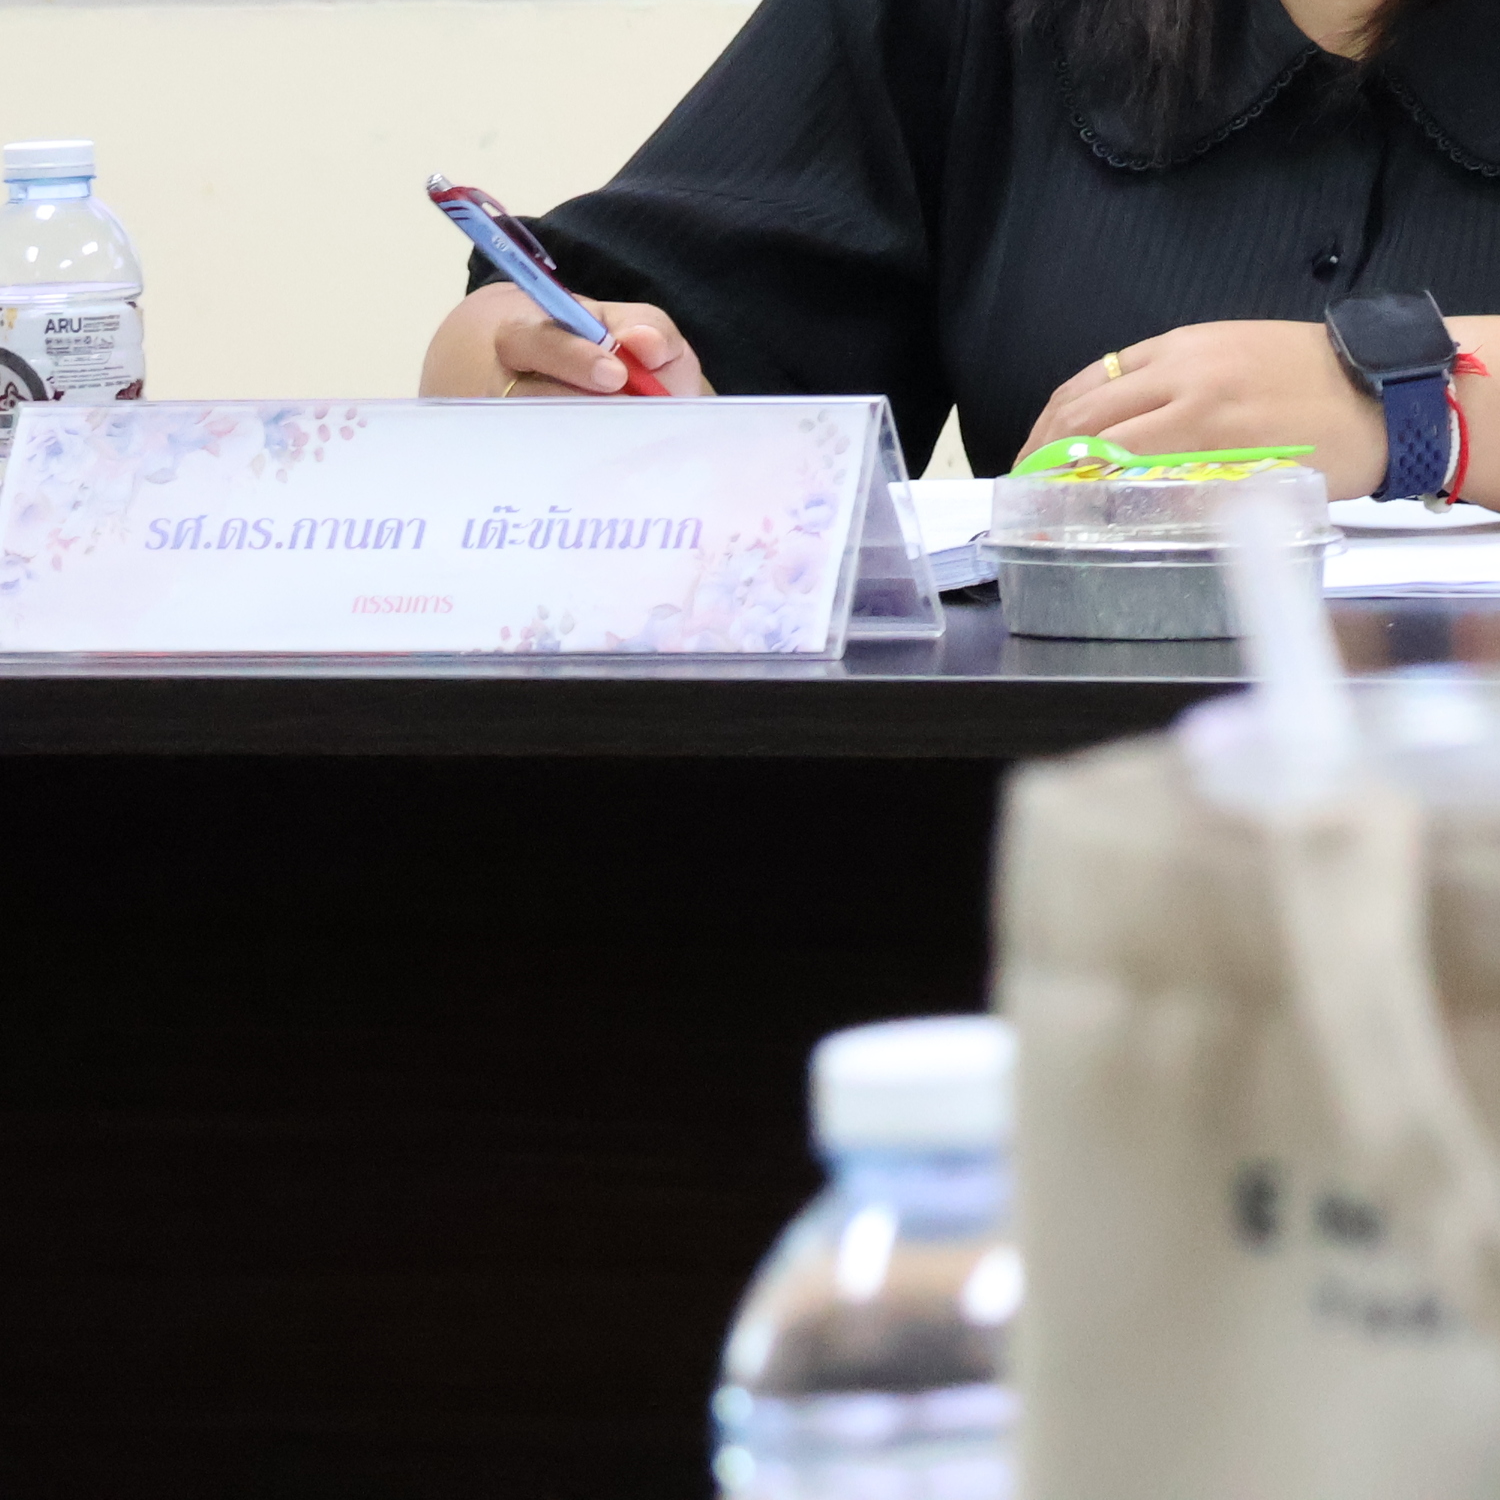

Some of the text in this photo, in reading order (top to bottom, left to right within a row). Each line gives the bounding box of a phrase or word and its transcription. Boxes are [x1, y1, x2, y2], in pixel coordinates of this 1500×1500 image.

[44, 317, 83, 335] ARU
[144, 504, 704, 551] รศ.ดร.กานดา เต๊ะขันหมาก
[351, 594, 455, 614] กรรมการ
